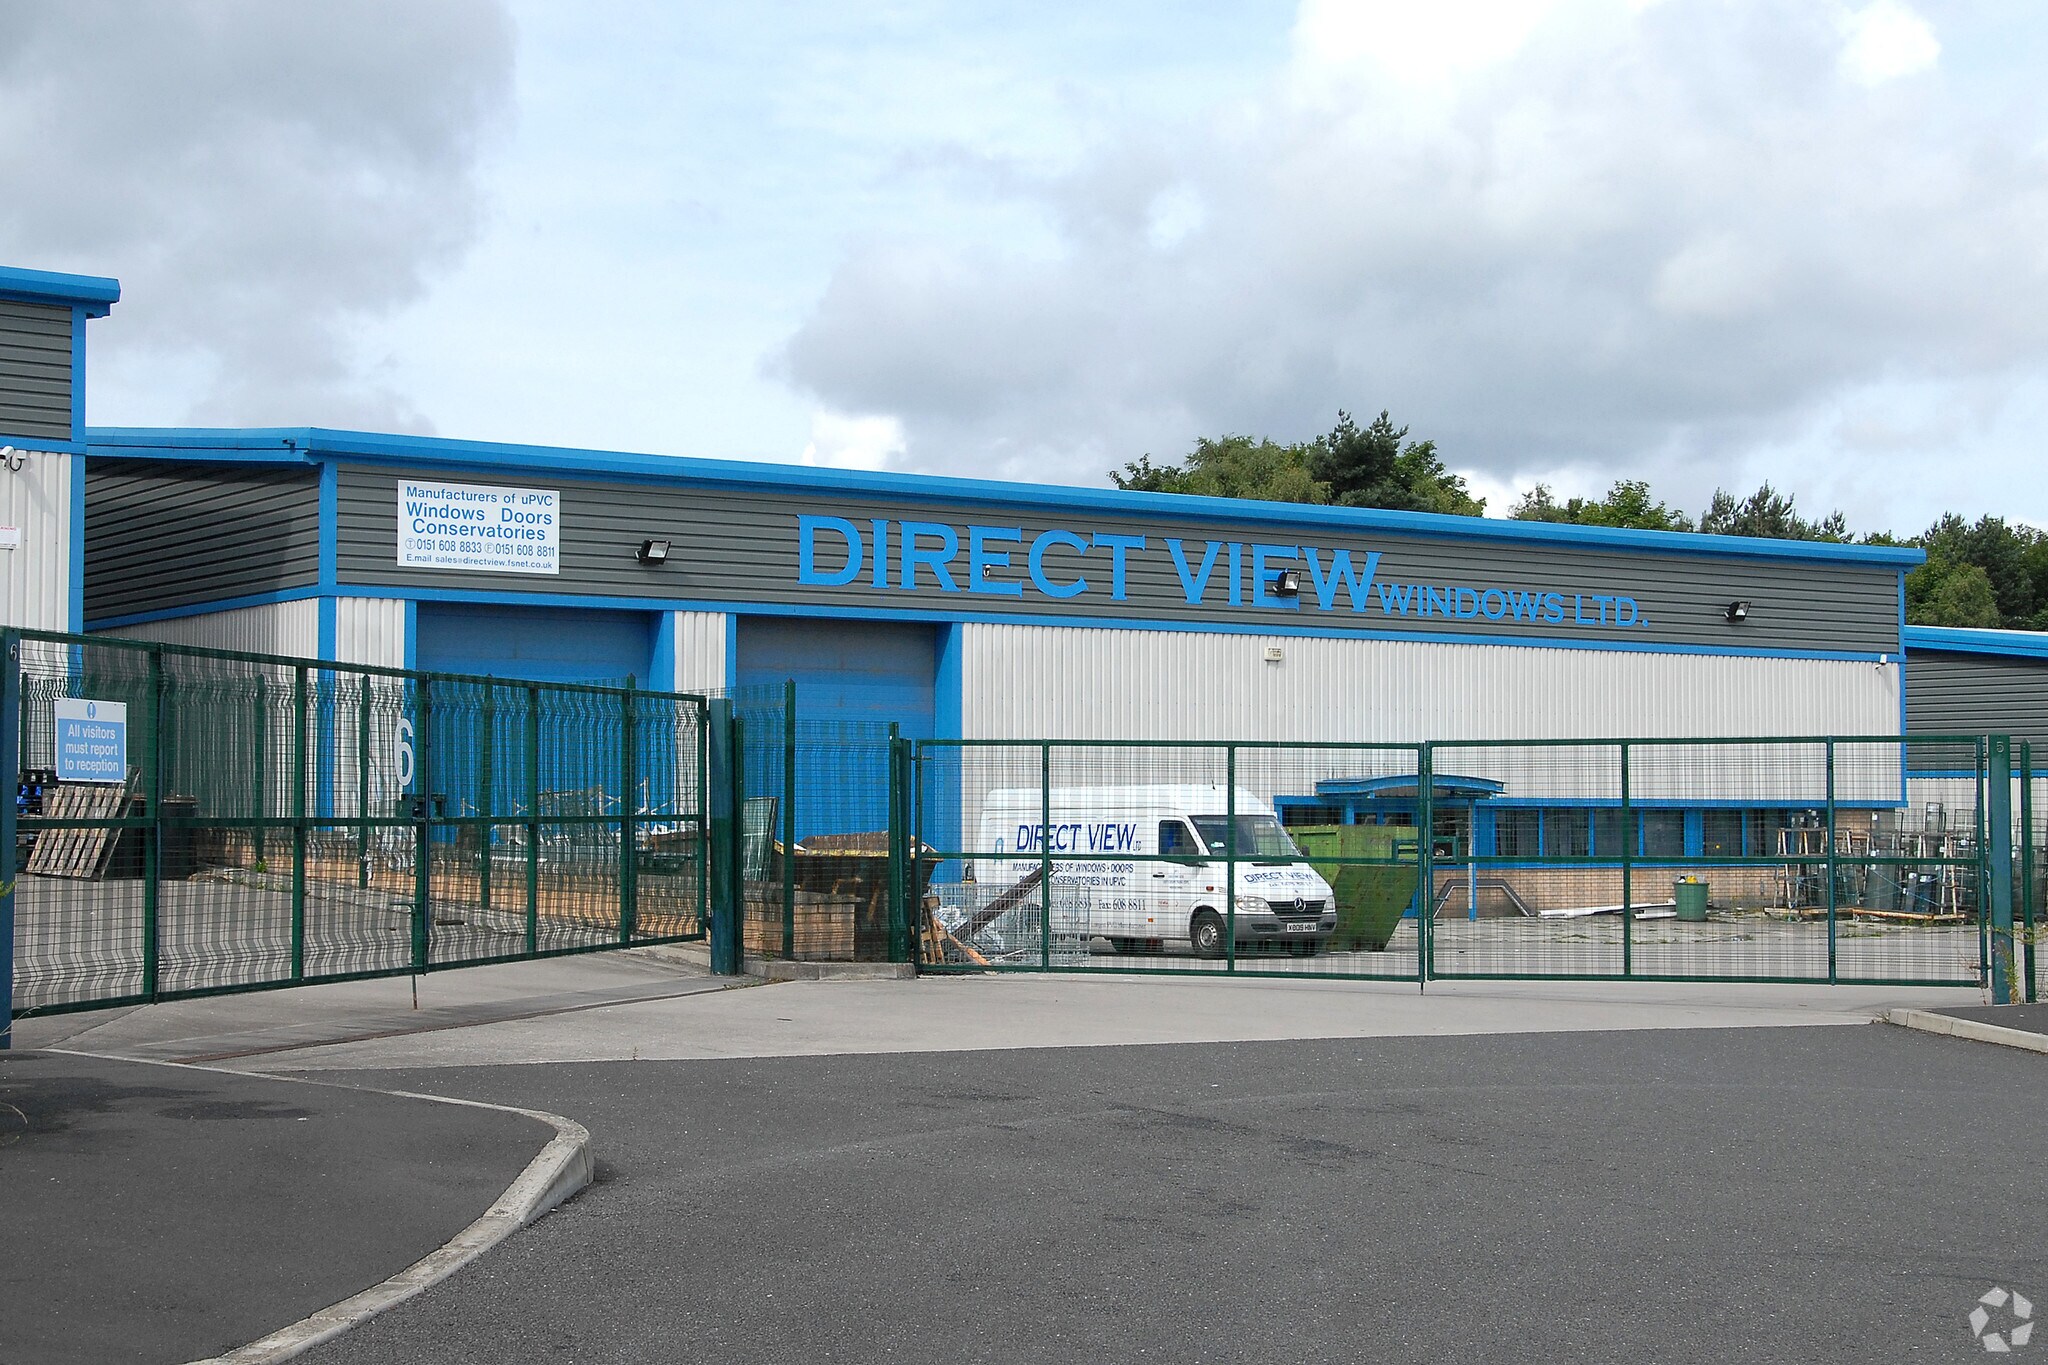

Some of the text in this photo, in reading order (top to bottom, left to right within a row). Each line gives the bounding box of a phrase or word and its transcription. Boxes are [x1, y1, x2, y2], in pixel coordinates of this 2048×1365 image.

[405, 485, 553, 507] Manufacturers of uPVC
[405, 501, 553, 525] Windows Doors
[412, 518, 546, 541] Conservatories
[416, 538, 436, 551] 0151
[438, 539, 456, 552] 608
[459, 540, 482, 553] 8833
[495, 543, 514, 555] 0151
[517, 544, 533, 557] 608
[536, 545, 555, 557] 8811
[796, 514, 1650, 628] DIRECT VIEW WINDOWS LTD.
[67, 723, 116, 740] All visitors
[65, 742, 118, 759] must report
[394, 718, 414, 786] 6
[65, 757, 119, 775] to reception
[1016, 824, 1082, 851] DIRECT
[1088, 823, 1137, 851] VIEW
[1047, 875, 1100, 886] ONSERVATORIES
[1243, 871, 1285, 884] DIRECT
[1112, 898, 1127, 911] 608
